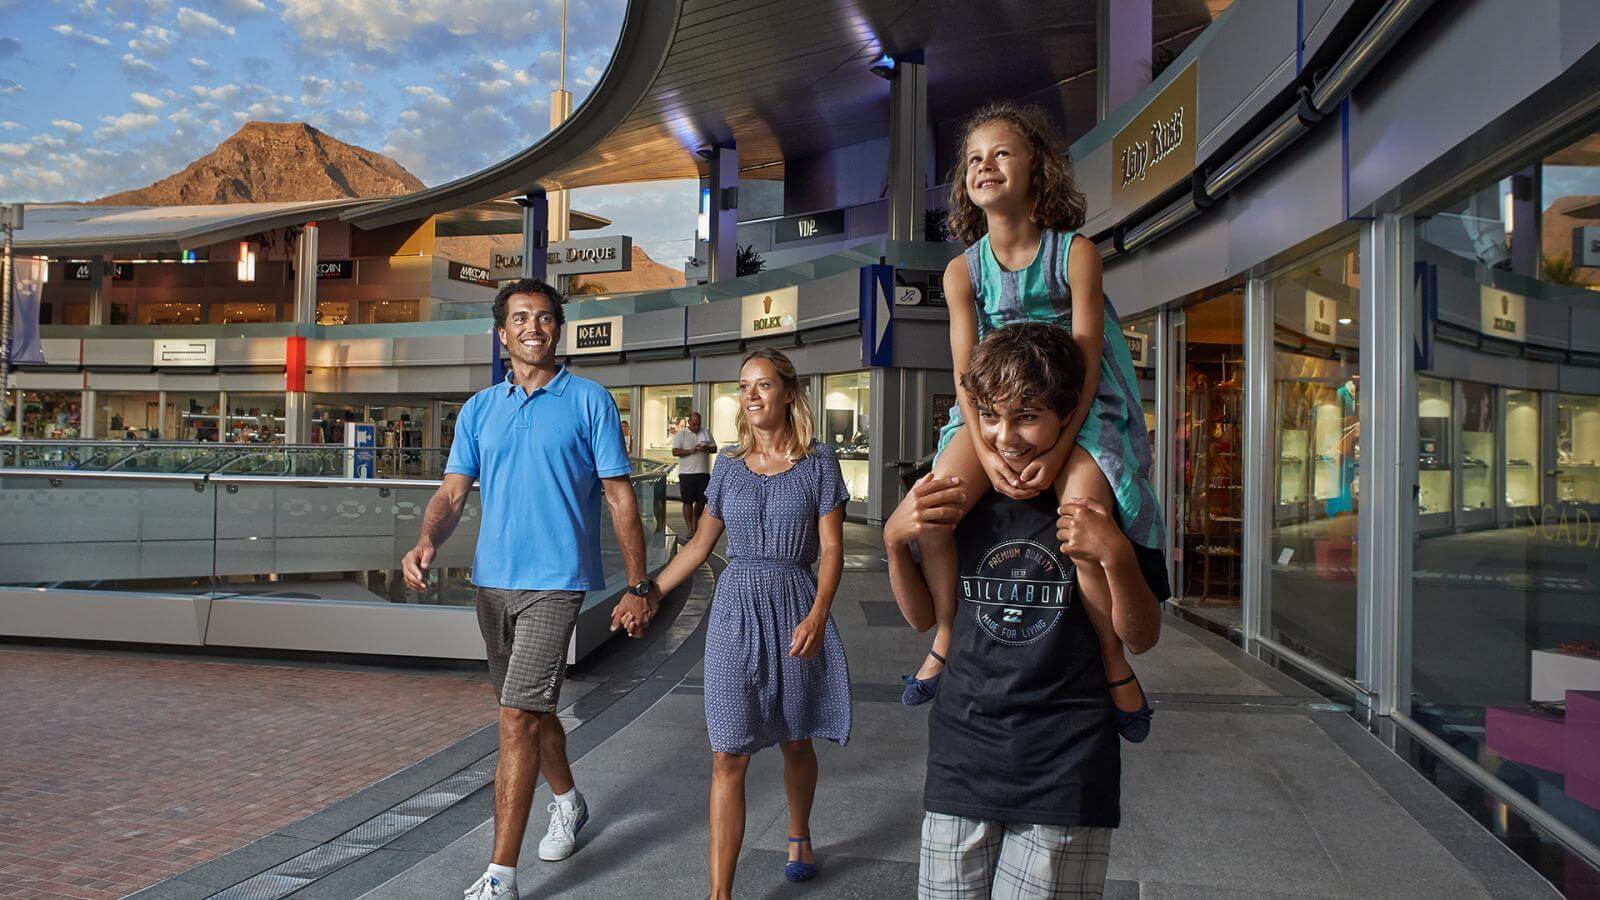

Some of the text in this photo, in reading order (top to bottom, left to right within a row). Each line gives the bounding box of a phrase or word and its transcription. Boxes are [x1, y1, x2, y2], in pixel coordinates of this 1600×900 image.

[495, 246, 616, 269] PLAZ EL DUQUE
[579, 325, 609, 339] IDEAL
[753, 315, 782, 331] ROLEX
[988, 548, 1054, 573] PREMIUM QUALITY
[981, 613, 1047, 639] MADE FOR LIVING
